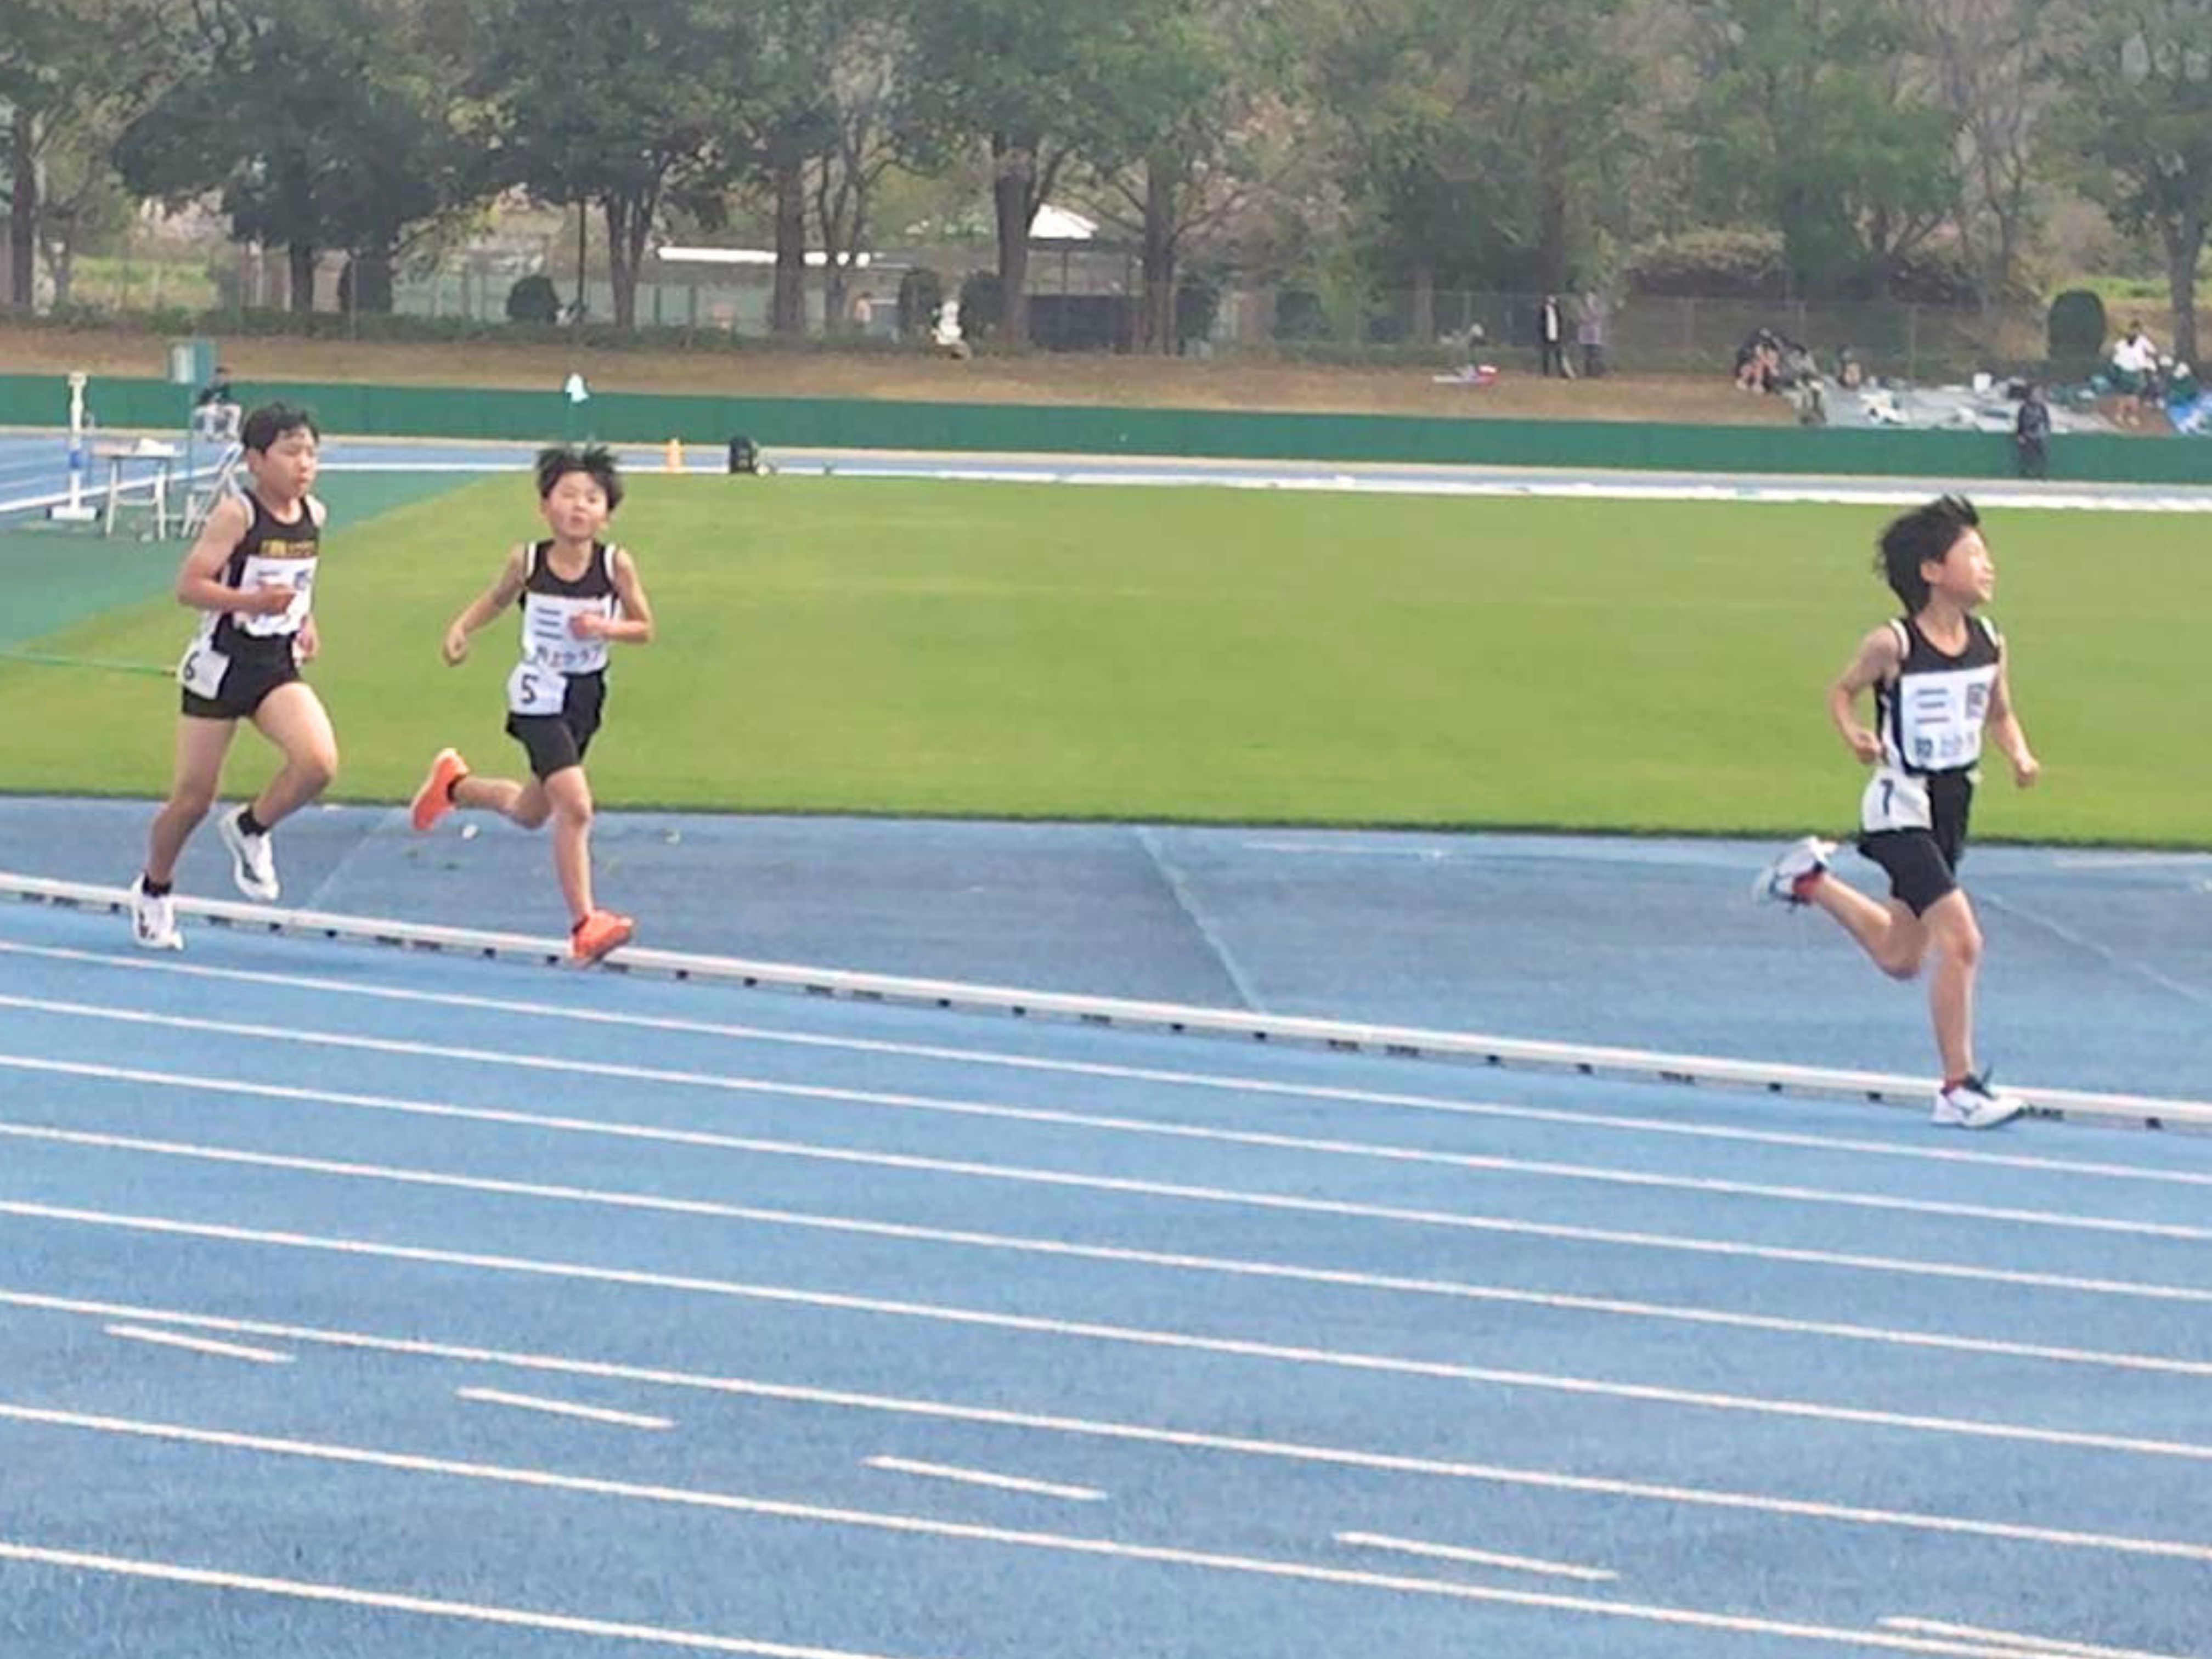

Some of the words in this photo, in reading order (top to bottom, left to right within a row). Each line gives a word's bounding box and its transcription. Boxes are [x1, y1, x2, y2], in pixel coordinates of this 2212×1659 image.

[183, 651, 200, 682] 6
[521, 673, 539, 704] 5
[1880, 778, 1894, 816] 7
